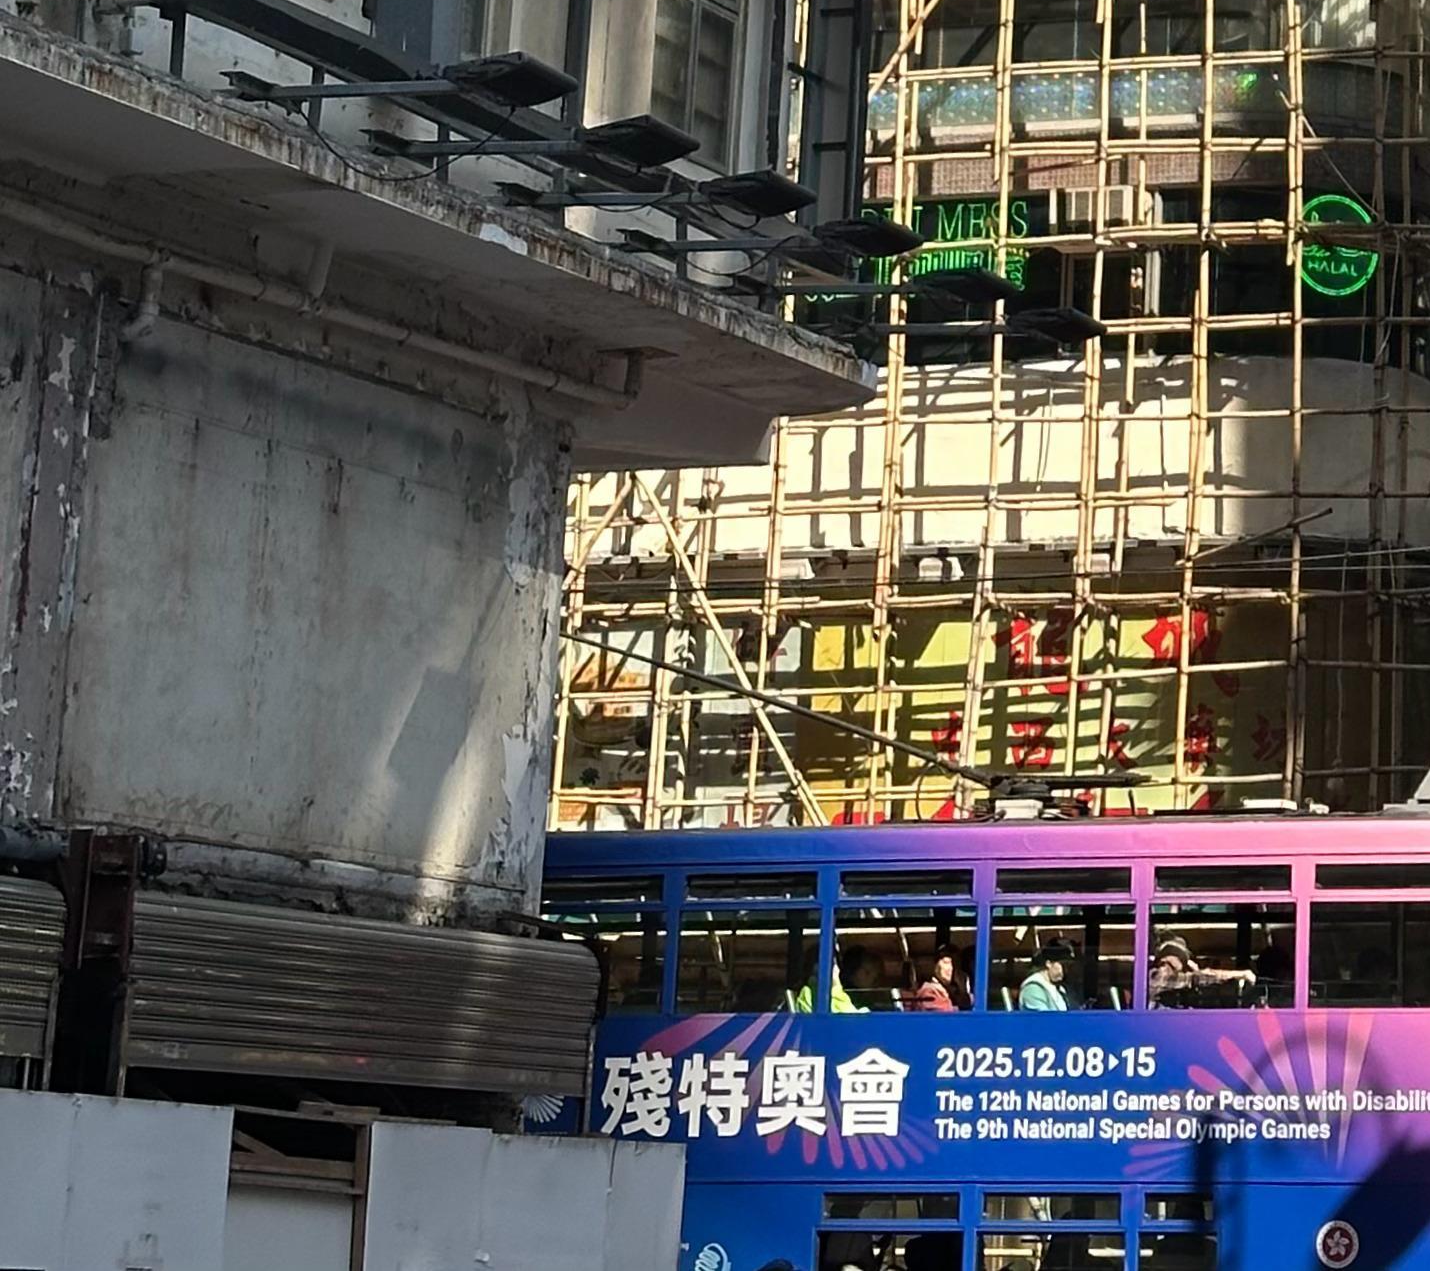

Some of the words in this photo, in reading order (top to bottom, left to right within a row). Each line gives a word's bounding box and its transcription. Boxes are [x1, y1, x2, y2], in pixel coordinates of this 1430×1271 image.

[937, 200, 1028, 242] MESS
[1308, 260, 1358, 276] HALAL
[600, 1047, 911, 1138] 殘特奧會
[936, 1090, 973, 1111] The
[979, 1090, 1021, 1111] 12th
[1026, 1090, 1107, 1111] National
[1112, 1091, 1180, 1112] Games
[1185, 1090, 1214, 1111] for
[1219, 1091, 1300, 1112] Persons
[1305, 1090, 1347, 1111] with
[935, 1118, 972, 1139] The
[977, 1118, 1007, 1139] 9th
[1013, 1118, 1094, 1139] National
[1099, 1118, 1170, 1144] Special
[1176, 1118, 1257, 1144] Olympic
[1262, 1119, 1331, 1139] Games
